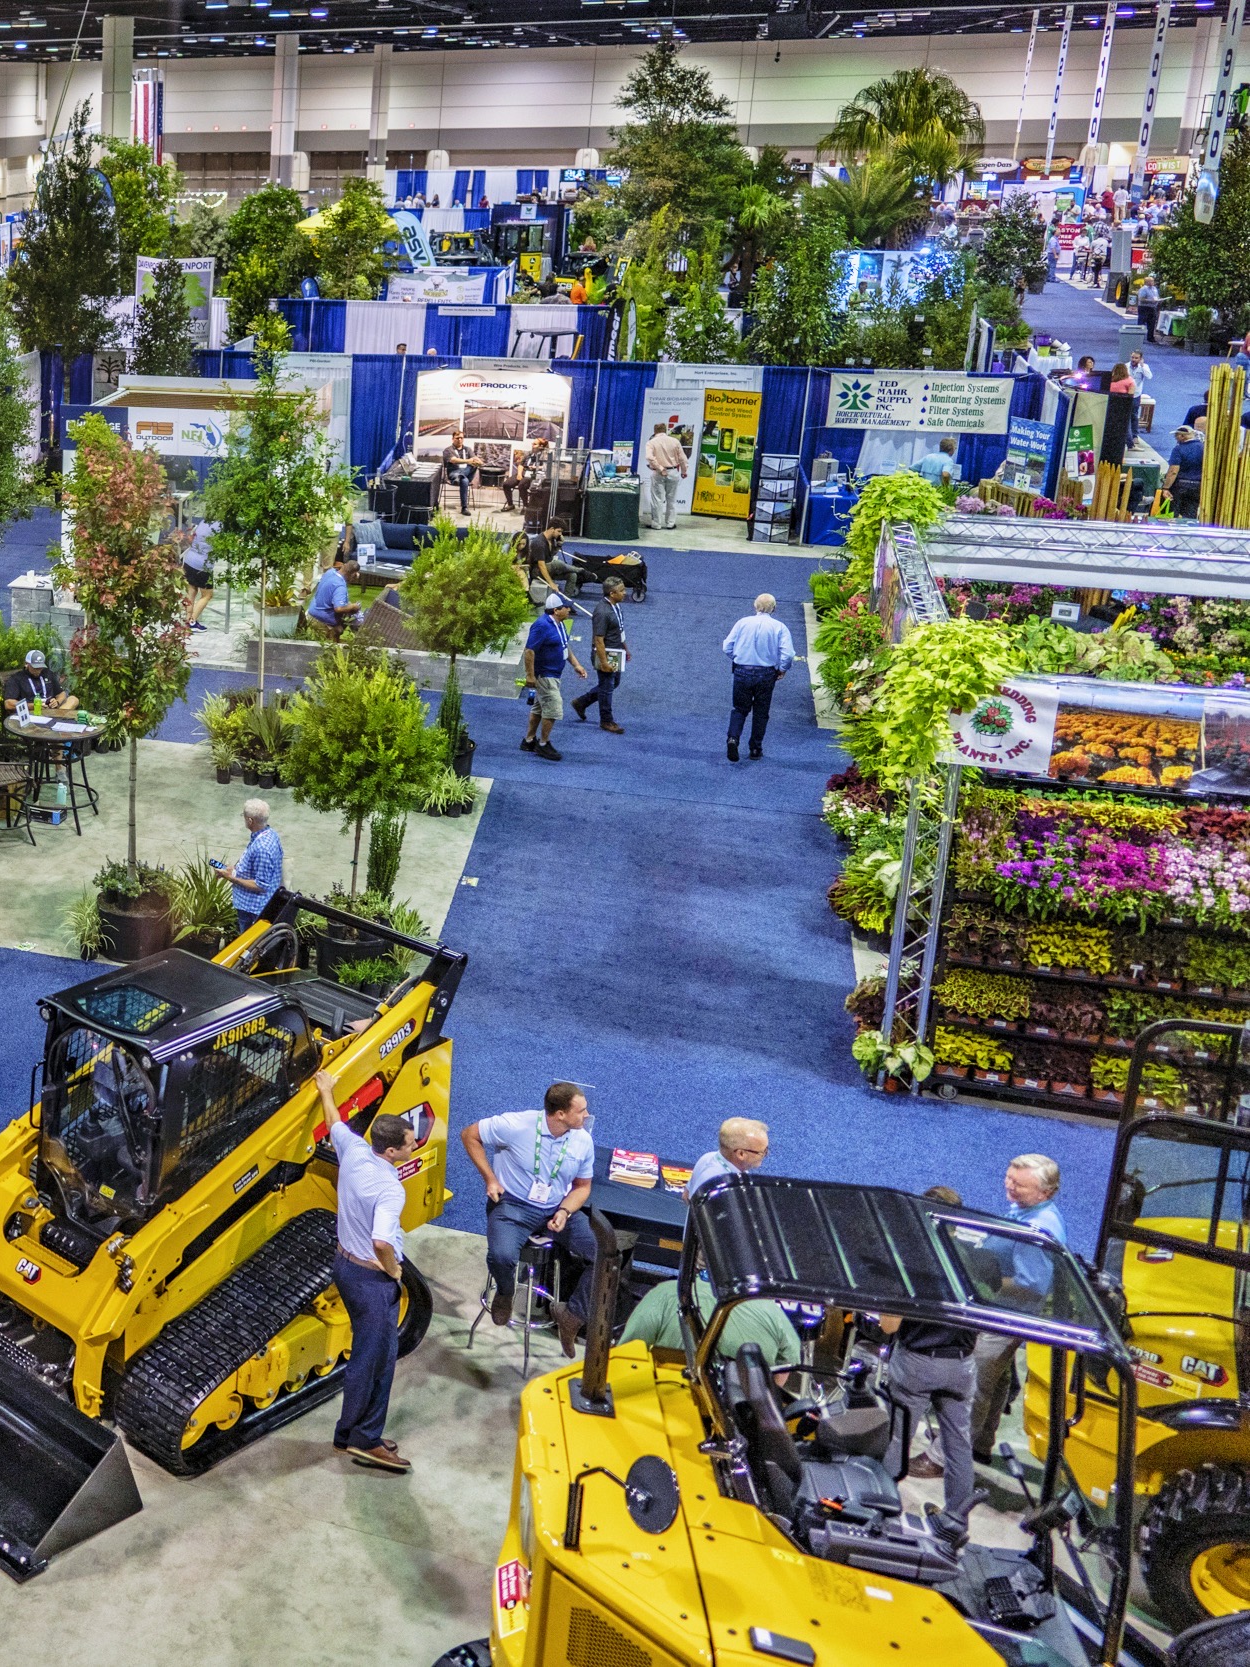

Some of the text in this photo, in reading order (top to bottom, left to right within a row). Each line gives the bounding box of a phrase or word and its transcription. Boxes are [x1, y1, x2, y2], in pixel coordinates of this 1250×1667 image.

[1050, 29, 1068, 131] 2200
[1090, 26, 1111, 138] 2100
[1140, 17, 1165, 147] 2000
[1209, 7, 1238, 158] 1900
[932, 383, 999, 393] Injection Systems
[930, 395, 1006, 405] Monitoring Systems
[836, 411, 892, 419] HORTICULTURAL
[929, 406, 984, 416] Filter Systems
[861, 418, 911, 426] MANAGEMENT
[946, 418, 984, 428] Chemicals
[1011, 426, 1050, 440] Making Your
[1010, 437, 1047, 451] Water Work
[1006, 738, 1033, 759] INC.
[16, 1258, 40, 1280] CAT
[1181, 1356, 1220, 1380] CAT
